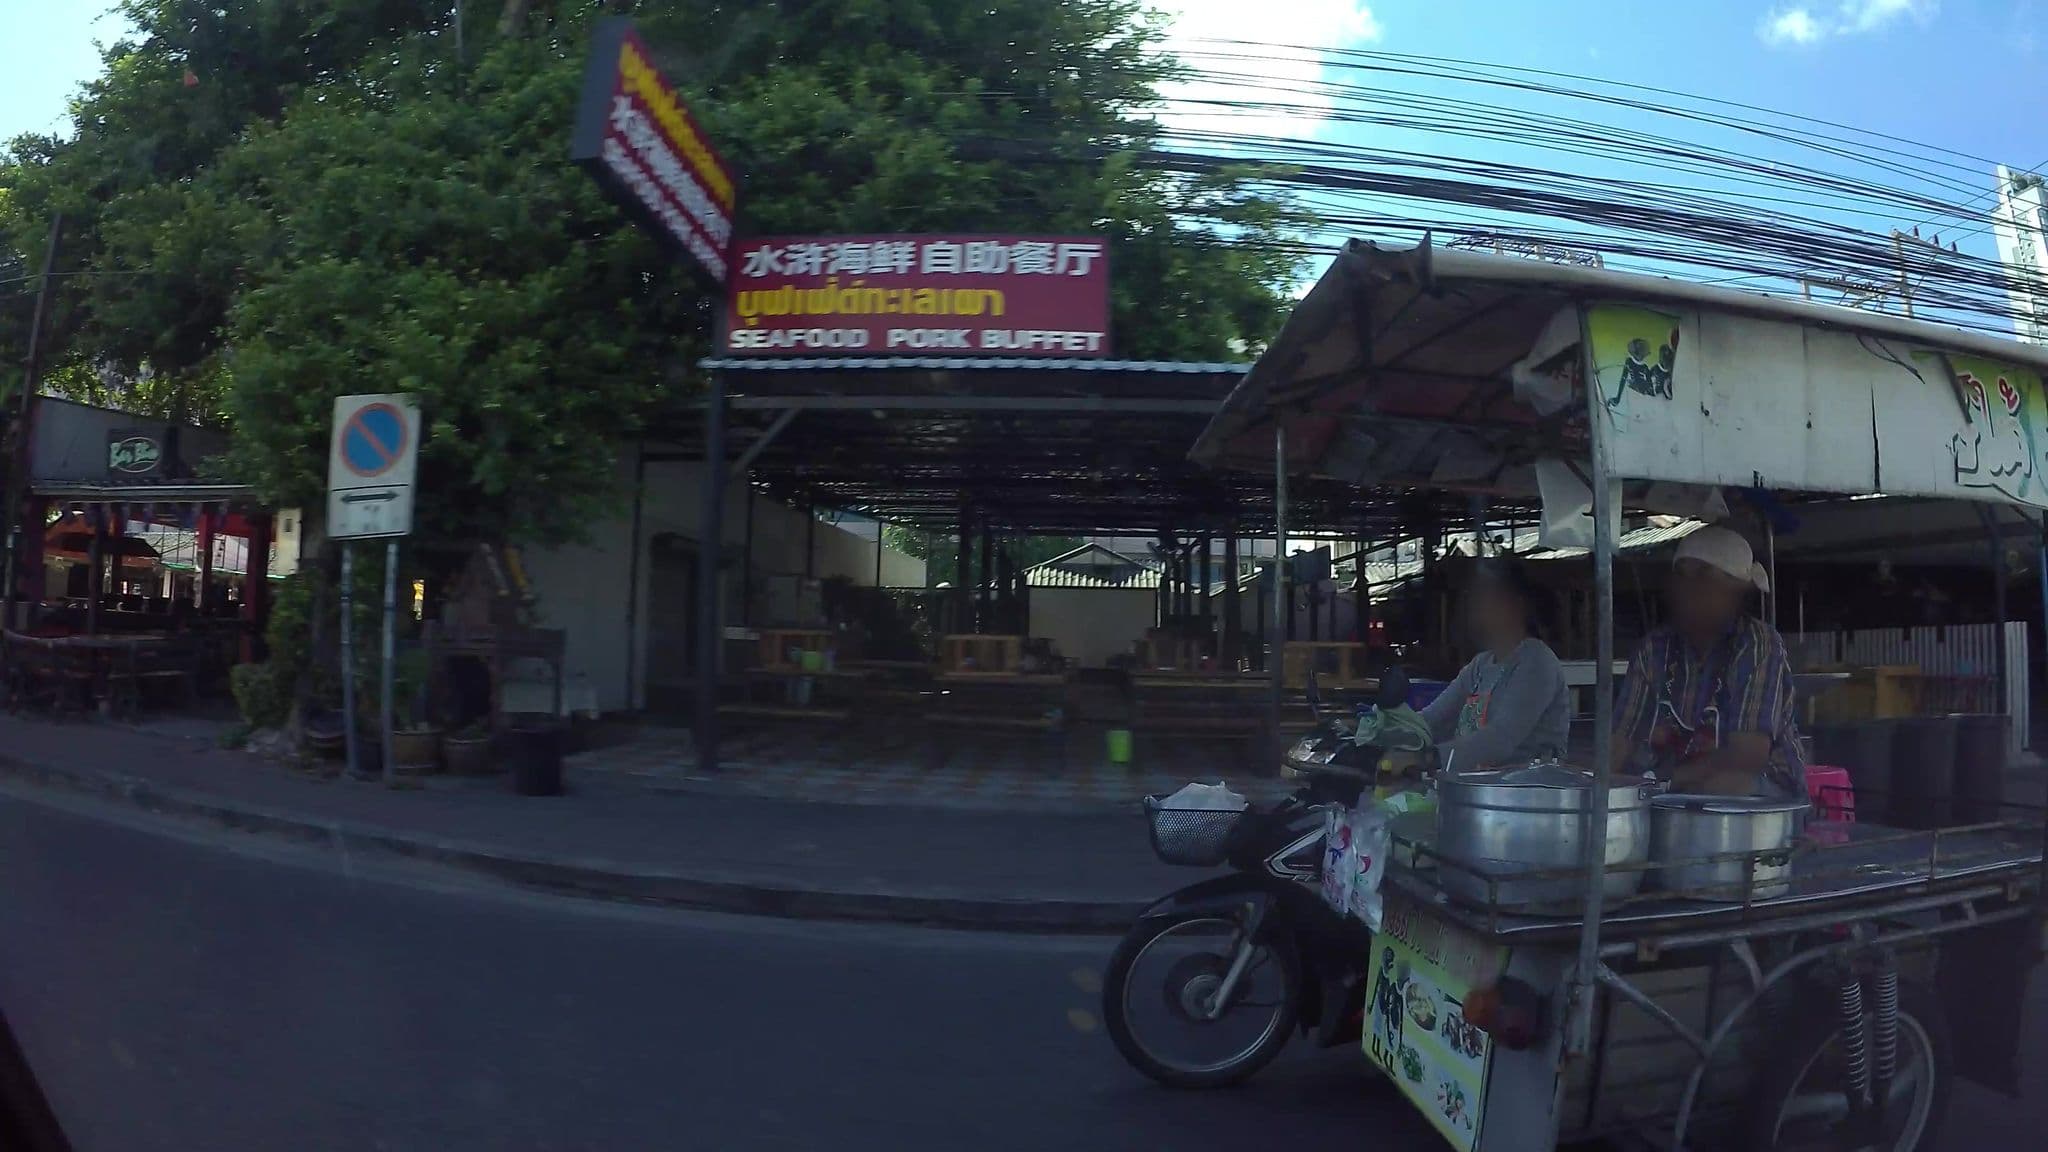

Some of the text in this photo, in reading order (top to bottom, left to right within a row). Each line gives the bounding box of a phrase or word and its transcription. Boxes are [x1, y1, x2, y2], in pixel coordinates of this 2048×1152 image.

[729, 327, 1104, 353] SEAFOOD PORK BUFFET
